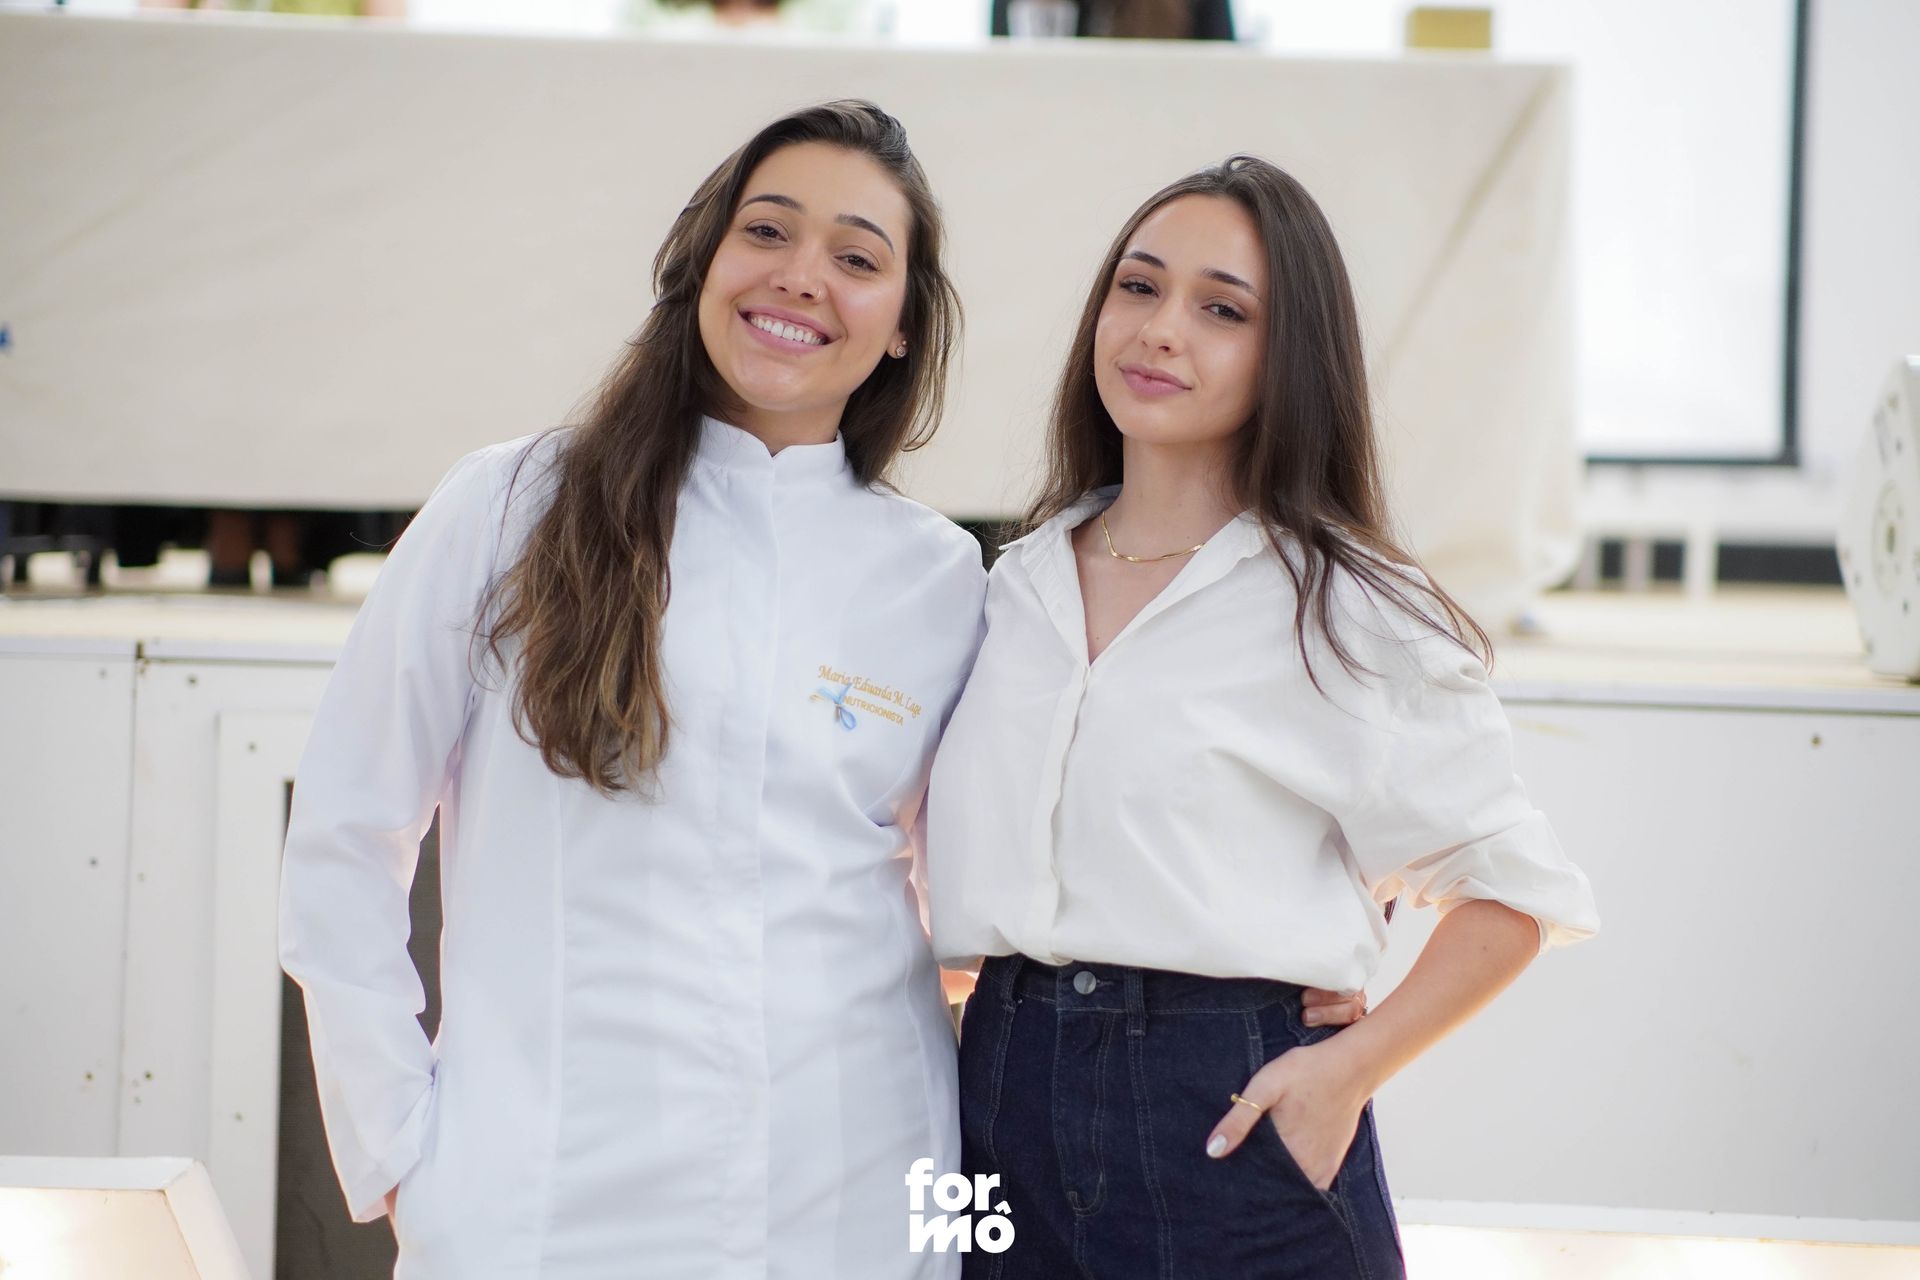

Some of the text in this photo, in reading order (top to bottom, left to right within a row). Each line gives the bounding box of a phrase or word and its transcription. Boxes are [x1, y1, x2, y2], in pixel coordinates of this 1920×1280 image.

[818, 664, 851, 686] Maria
[852, 675, 893, 700] Eduarda
[843, 694, 904, 726] NUTRICIONISTA
